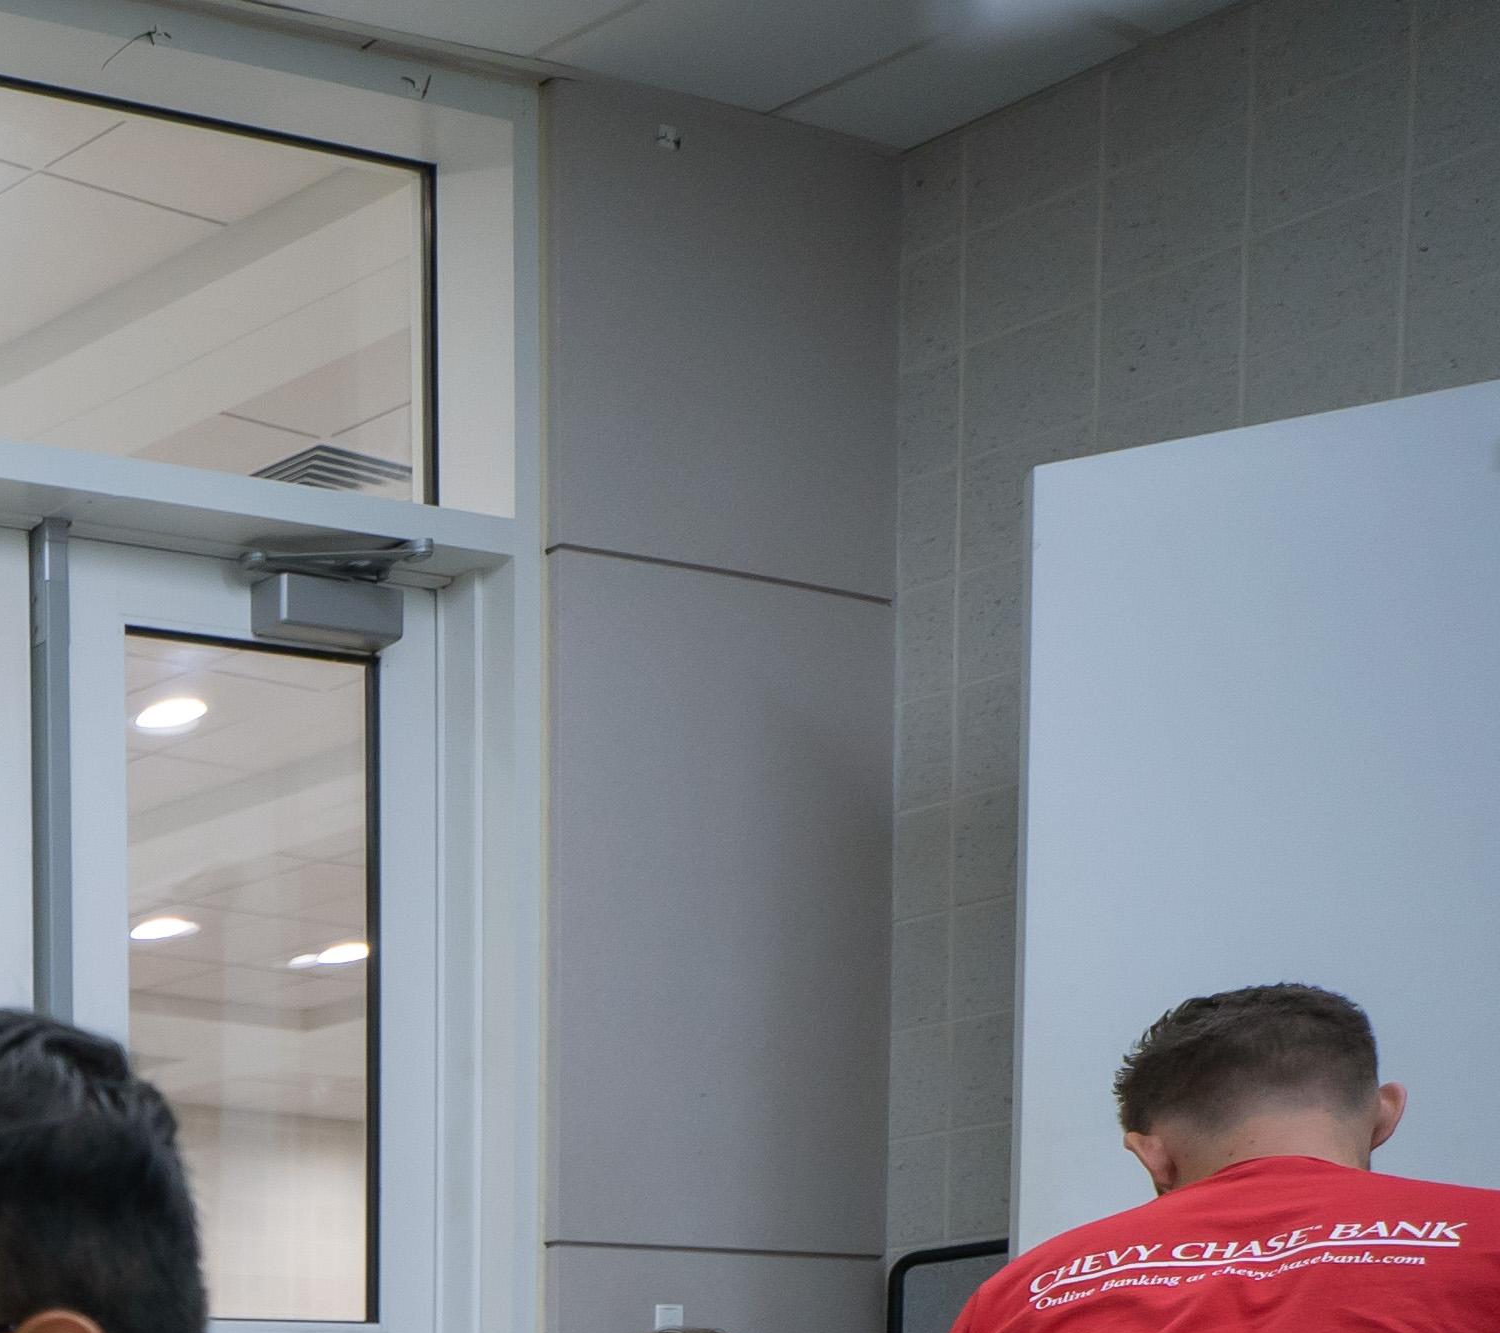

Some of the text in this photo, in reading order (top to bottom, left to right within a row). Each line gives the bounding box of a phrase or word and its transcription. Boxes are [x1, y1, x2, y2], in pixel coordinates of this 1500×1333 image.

[1029, 1220, 1468, 1294] CHEVY CHASE BANK
[1035, 1251, 1426, 1310] Online Banking at chevychasebank.com
